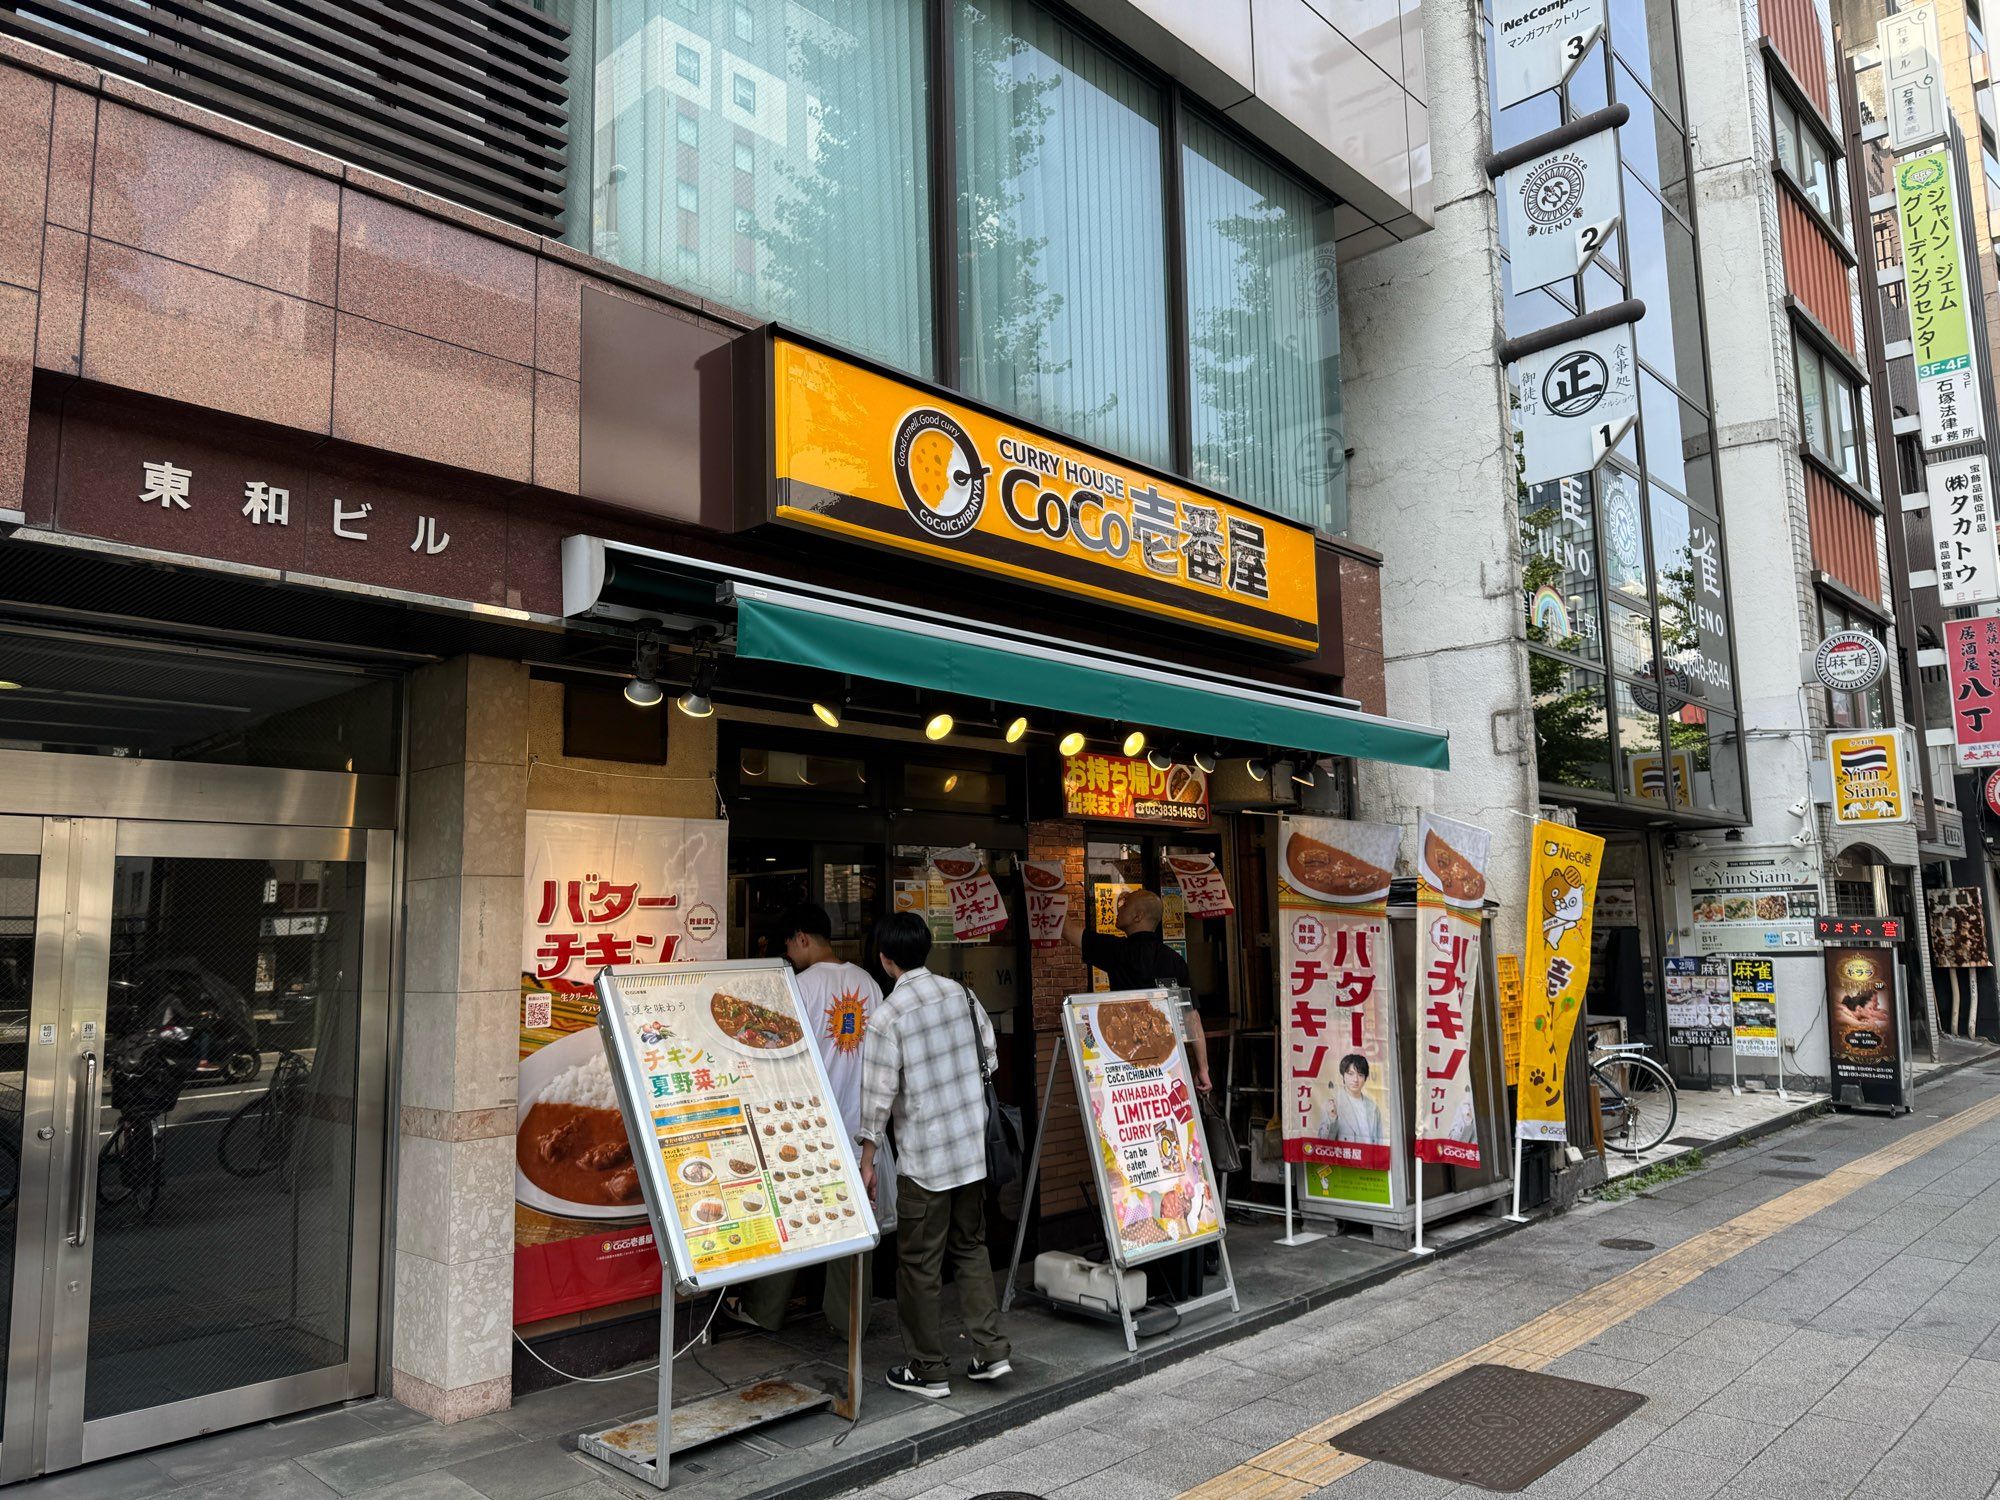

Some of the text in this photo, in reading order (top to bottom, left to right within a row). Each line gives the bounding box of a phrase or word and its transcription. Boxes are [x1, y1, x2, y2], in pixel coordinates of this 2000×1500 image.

[1507, 6, 1591, 49] マンガファクトリー
[1567, 35, 1585, 60] 3
[1923, 73, 1934, 86] 6
[1562, 152, 1588, 171] place
[1539, 217, 1572, 236] UENO
[1581, 227, 1599, 253] 2
[1926, 186, 1958, 312] ジャパン・ジェム
[1903, 192, 1936, 360] グレーディングセンター
[1613, 343, 1631, 389] 食事処
[1521, 371, 1538, 416] 御徒町
[1936, 378, 1959, 431] 石塚法律
[897, 437, 909, 467] Good
[919, 414, 940, 426] Good
[940, 419, 960, 438] curry
[1599, 424, 1612, 448] 1
[1930, 427, 1975, 445] 事務所
[999, 438, 1125, 500] CURRY HOUSE
[139, 461, 450, 556] 東和ビル
[919, 479, 982, 532] CoCoICHIBANYA
[1000, 468, 1270, 600] CoCo壱番屋
[1538, 528, 1591, 577] UENO
[1939, 540, 1954, 591] 商品管理室
[1688, 600, 1724, 638] UENO
[1827, 652, 1868, 670] 麻雀
[1959, 625, 1980, 673] 居酒屋
[1958, 676, 1994, 733] 八丁
[1066, 755, 1166, 797] お持ち帰り
[1845, 768, 1879, 782] Yim
[1844, 784, 1890, 799] Siam
[1145, 804, 1197, 819] 03-3835-1435
[1559, 847, 1593, 867] NeCo壱
[1181, 874, 1221, 889] バター
[1714, 869, 1792, 885] Yim Siam
[537, 872, 677, 925] バター
[950, 879, 991, 903] バター
[1186, 889, 1226, 904] チキン
[954, 893, 999, 922] チキン
[1298, 923, 1316, 934] 数量
[1298, 934, 1316, 945] 限定
[536, 932, 681, 979] チキン
[1678, 960, 1695, 971] 2階
[1700, 963, 1728, 976] 麻雀
[1733, 961, 1772, 980] 麻雀
[1334, 925, 1381, 1047] バター
[1756, 982, 1774, 992] 2F
[1291, 960, 1329, 1128] チキン カレー
[1426, 960, 1467, 1129] チキン カレー
[644, 1046, 716, 1072] チキンと
[1105, 1062, 1139, 1074] CURRY HOUSE
[648, 1068, 754, 1099] 夏野菜カレー
[1107, 1067, 1164, 1084] CoCo ICHIBANYA
[1111, 1082, 1168, 1104] AKIHABARA
[1114, 1098, 1171, 1126] LIMITED
[1118, 1123, 1153, 1143] CURRY
[1123, 1147, 1148, 1161] Can be
[1126, 1159, 1147, 1173] eaten
[1315, 1147, 1362, 1161] CoCo壱番屋
[1128, 1166, 1161, 1185] anytime!
[612, 1233, 653, 1250] CoCo壱番屋
